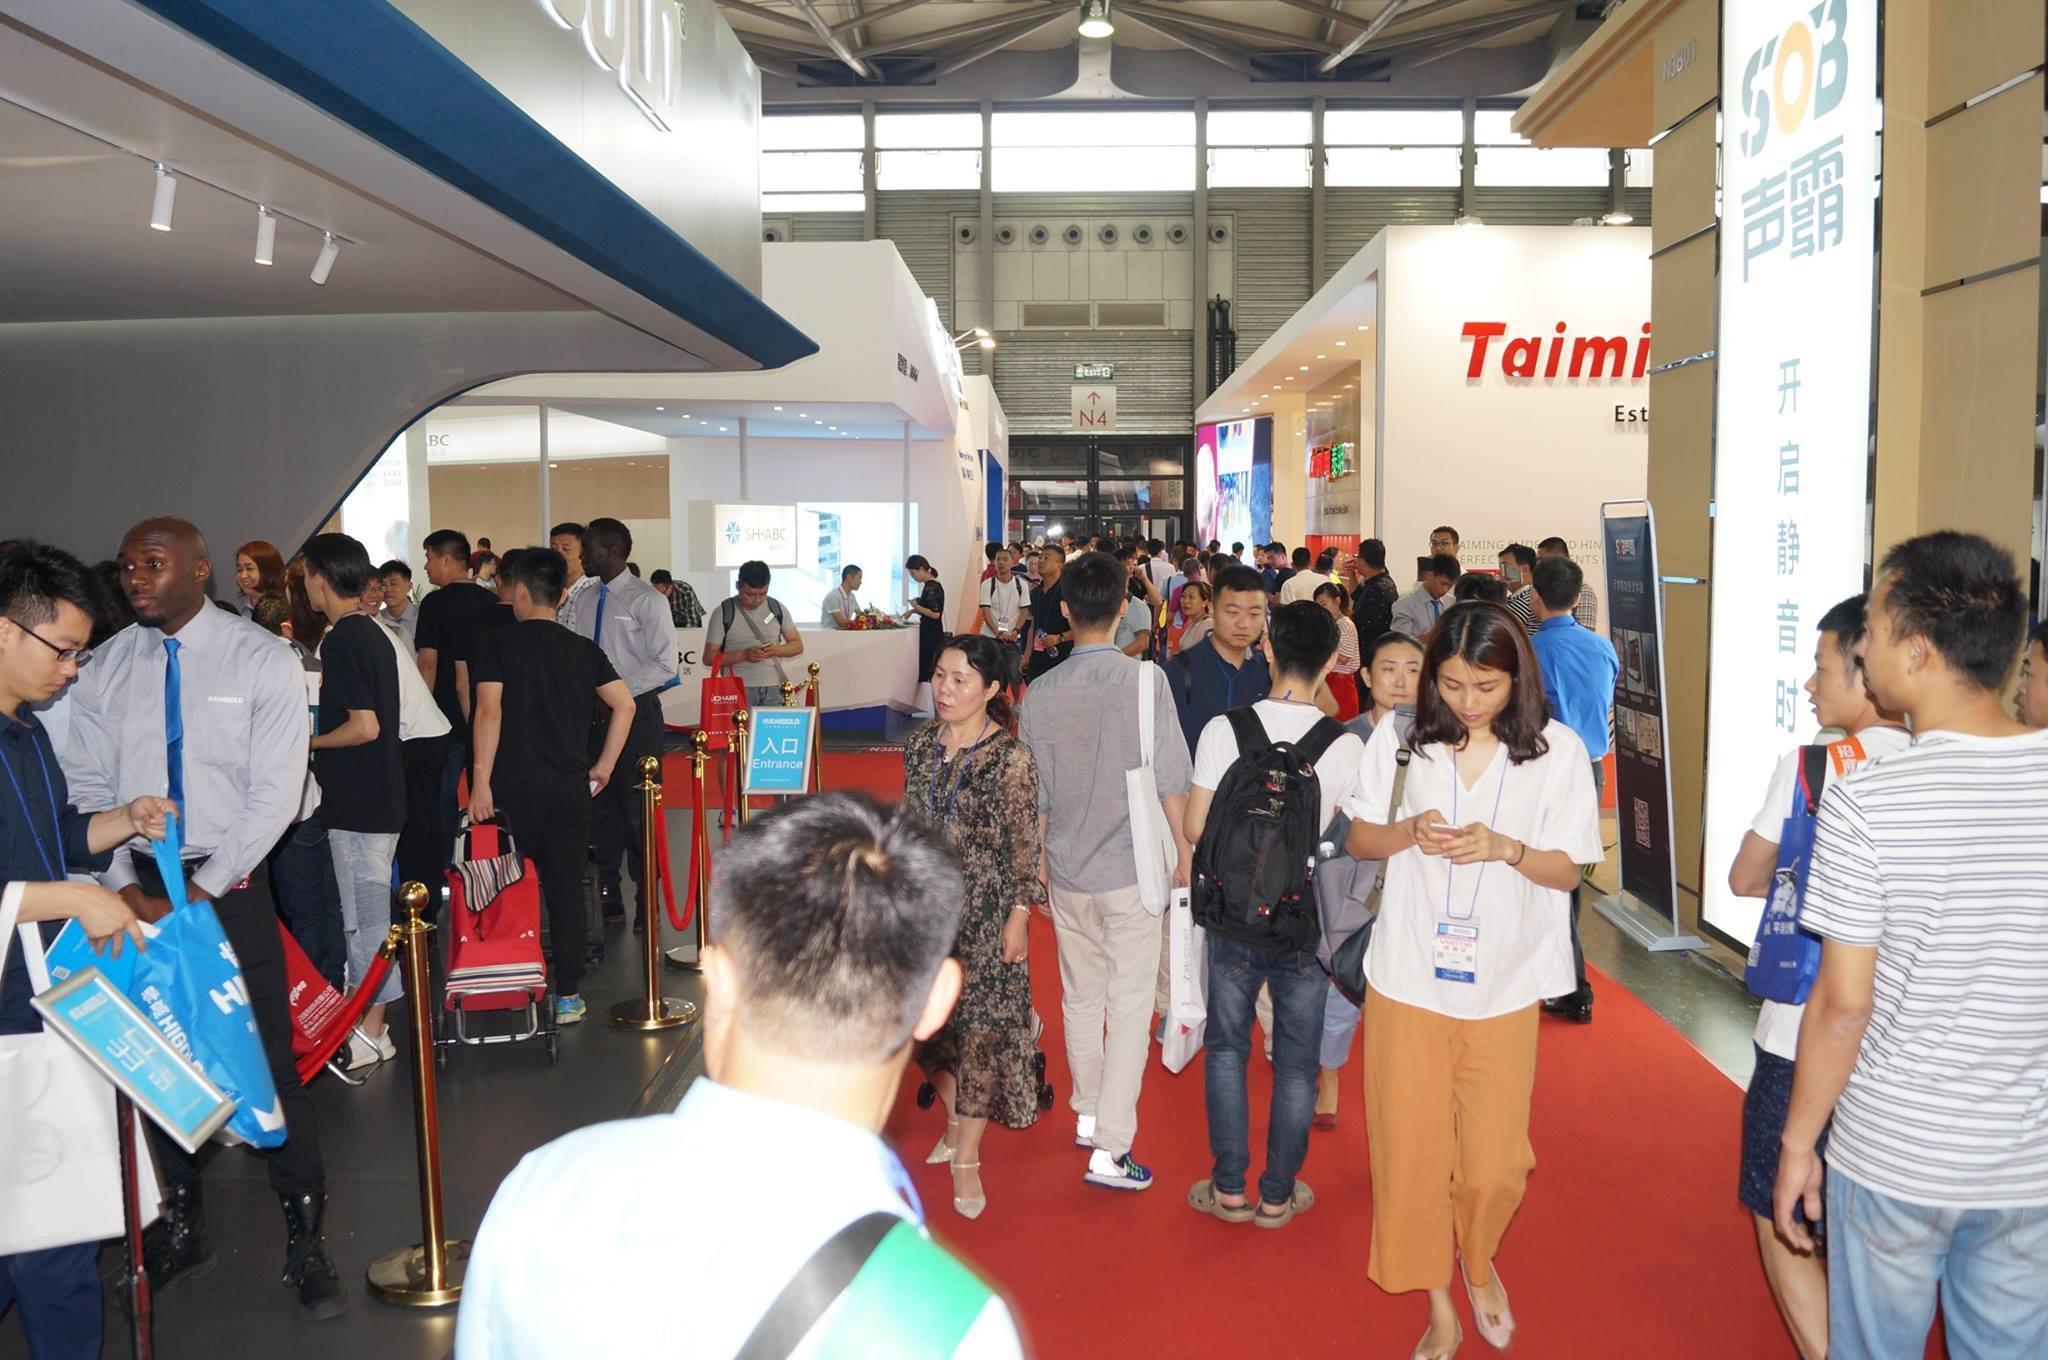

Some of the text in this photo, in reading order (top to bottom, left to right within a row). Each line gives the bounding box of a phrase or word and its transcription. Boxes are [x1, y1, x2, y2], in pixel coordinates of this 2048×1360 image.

[1740, 0, 1848, 159] SOB
[1461, 321, 1651, 378] Taimi
[1079, 409, 1108, 427] N4
[426, 434, 450, 447] BC
[1775, 357, 1801, 768] 开启静音时
[760, 737, 799, 755] 入口
[752, 758, 804, 769] Entrance
